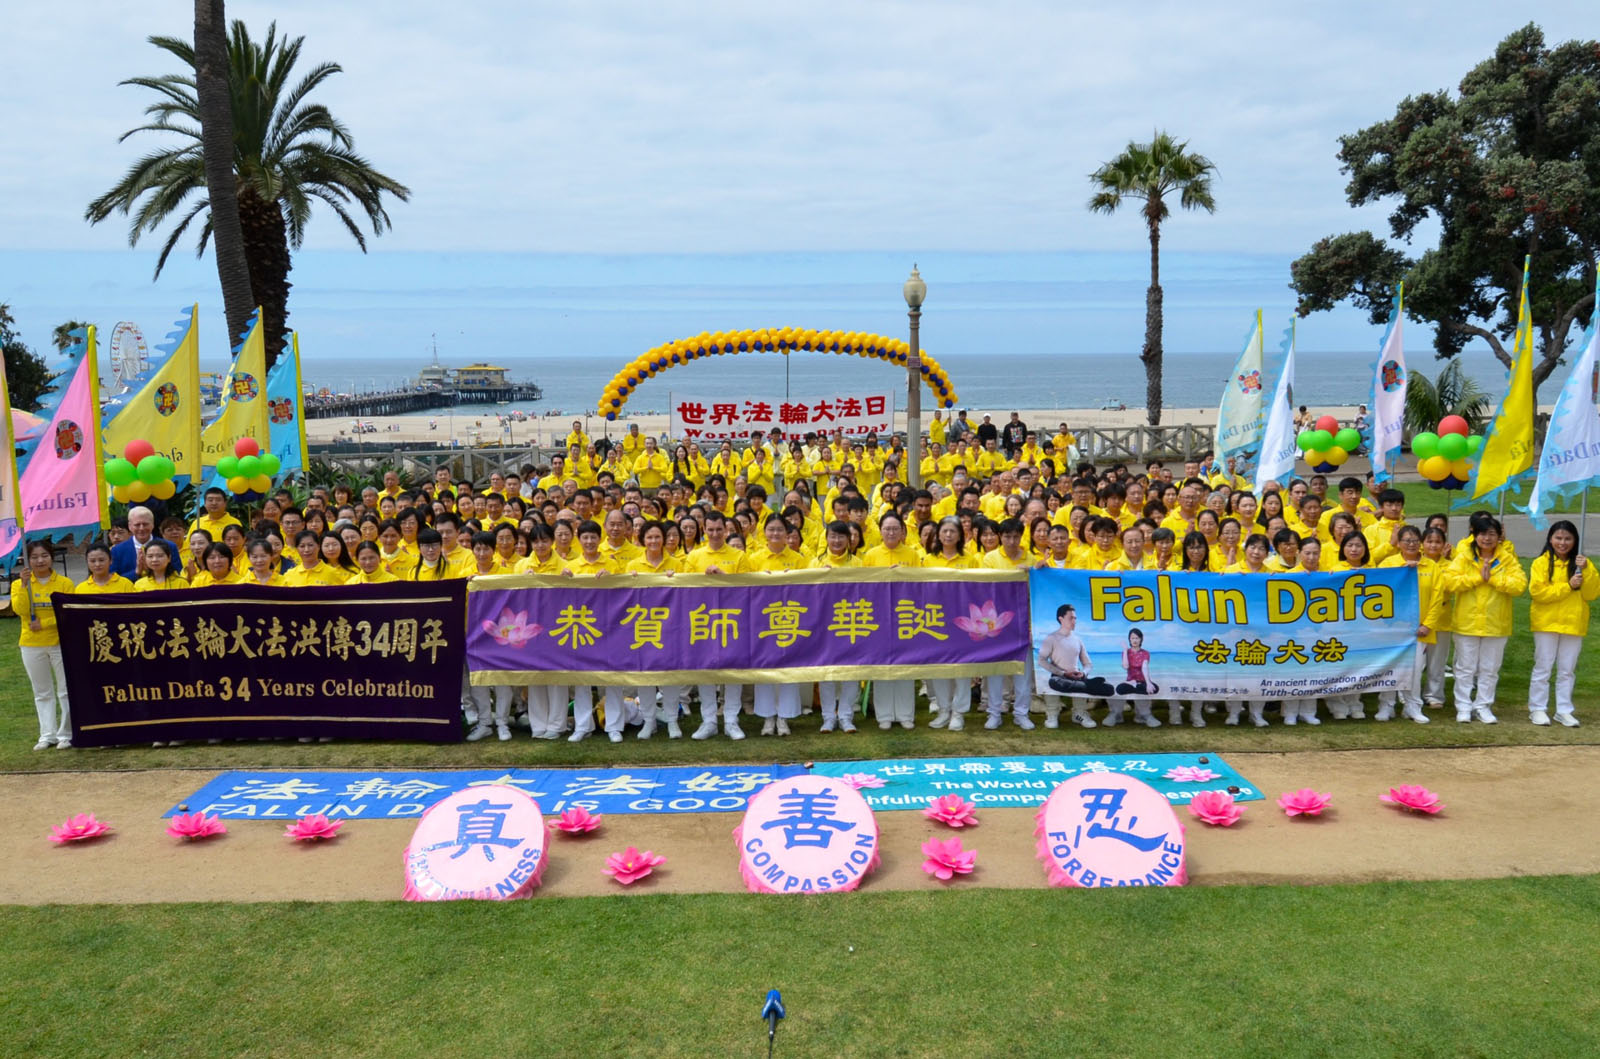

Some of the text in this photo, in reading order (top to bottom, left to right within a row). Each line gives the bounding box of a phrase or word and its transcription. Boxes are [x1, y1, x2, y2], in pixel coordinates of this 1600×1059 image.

[677, 396, 886, 426] 世界法輪大法日
[684, 428, 749, 439] World
[1089, 574, 1394, 624] Falun Dafa
[548, 598, 949, 650] 恭賀師尊華誕
[1193, 637, 1349, 666] 法輪大法
[103, 676, 434, 704] Falun Dafa 34 Years Celebration
[1275, 679, 1306, 687] ancient
[931, 781, 974, 790] The
[977, 780, 1047, 790] World
[200, 797, 746, 816] FALUN IS GOO
[760, 788, 857, 850] 善
[1073, 788, 1168, 852] 忍
[420, 799, 526, 862] 真
[746, 833, 874, 892] COMPASSION
